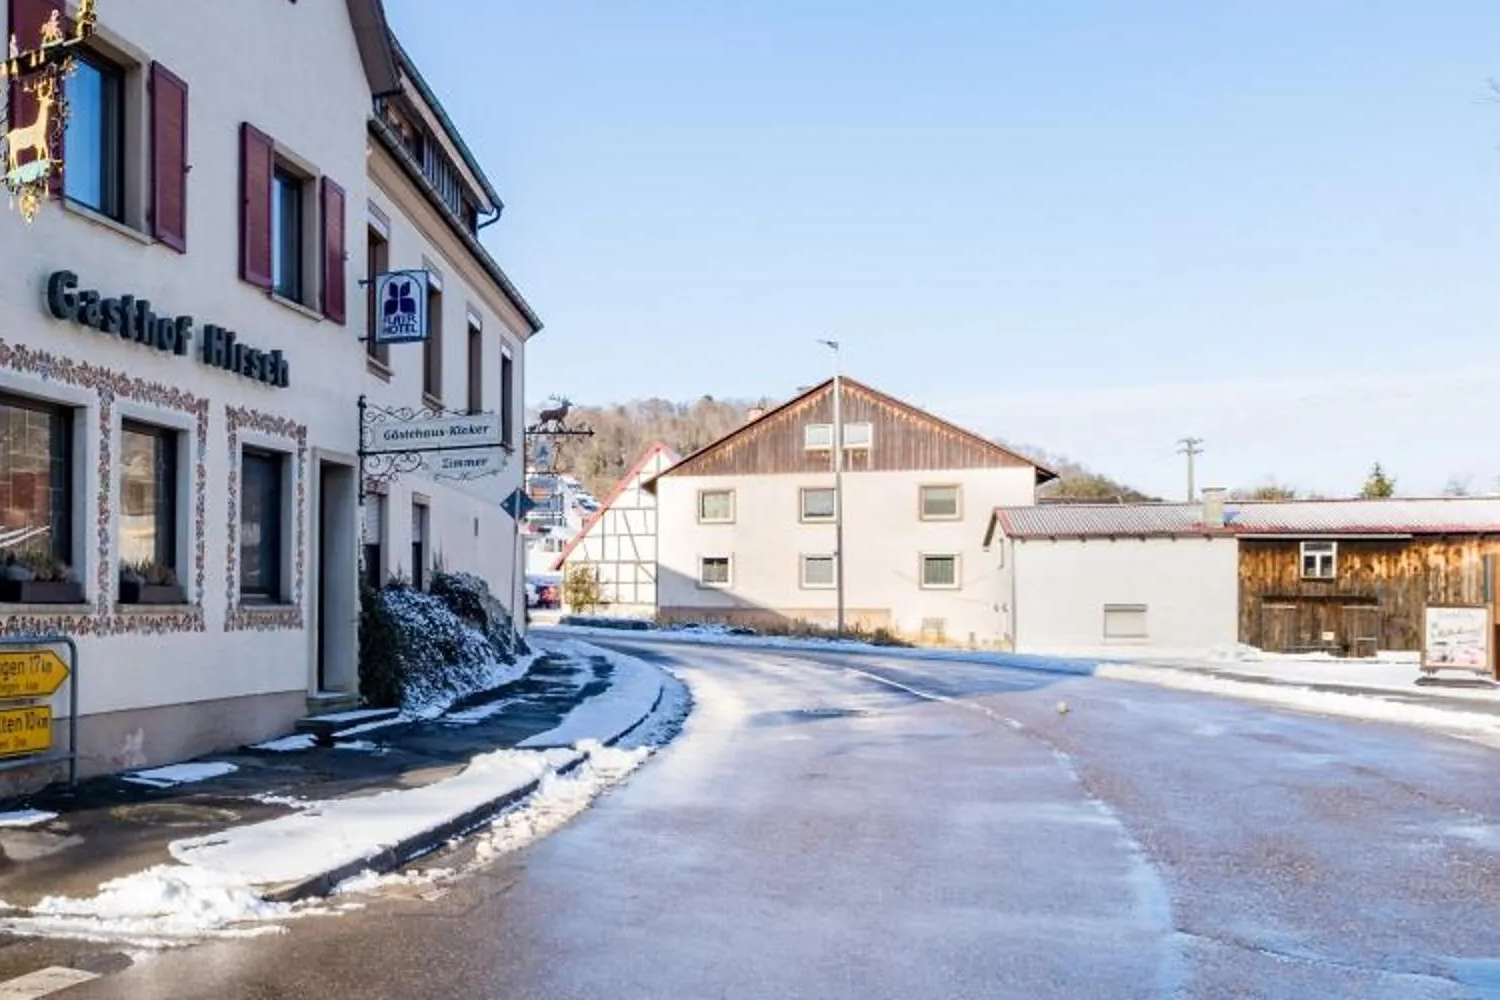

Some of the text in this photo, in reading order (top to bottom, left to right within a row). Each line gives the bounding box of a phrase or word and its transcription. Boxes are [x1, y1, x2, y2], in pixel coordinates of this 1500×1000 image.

[47, 269, 290, 388] Gasthof Hirsch
[382, 323, 418, 335] HOTEL
[441, 457, 489, 469] Zimmer
